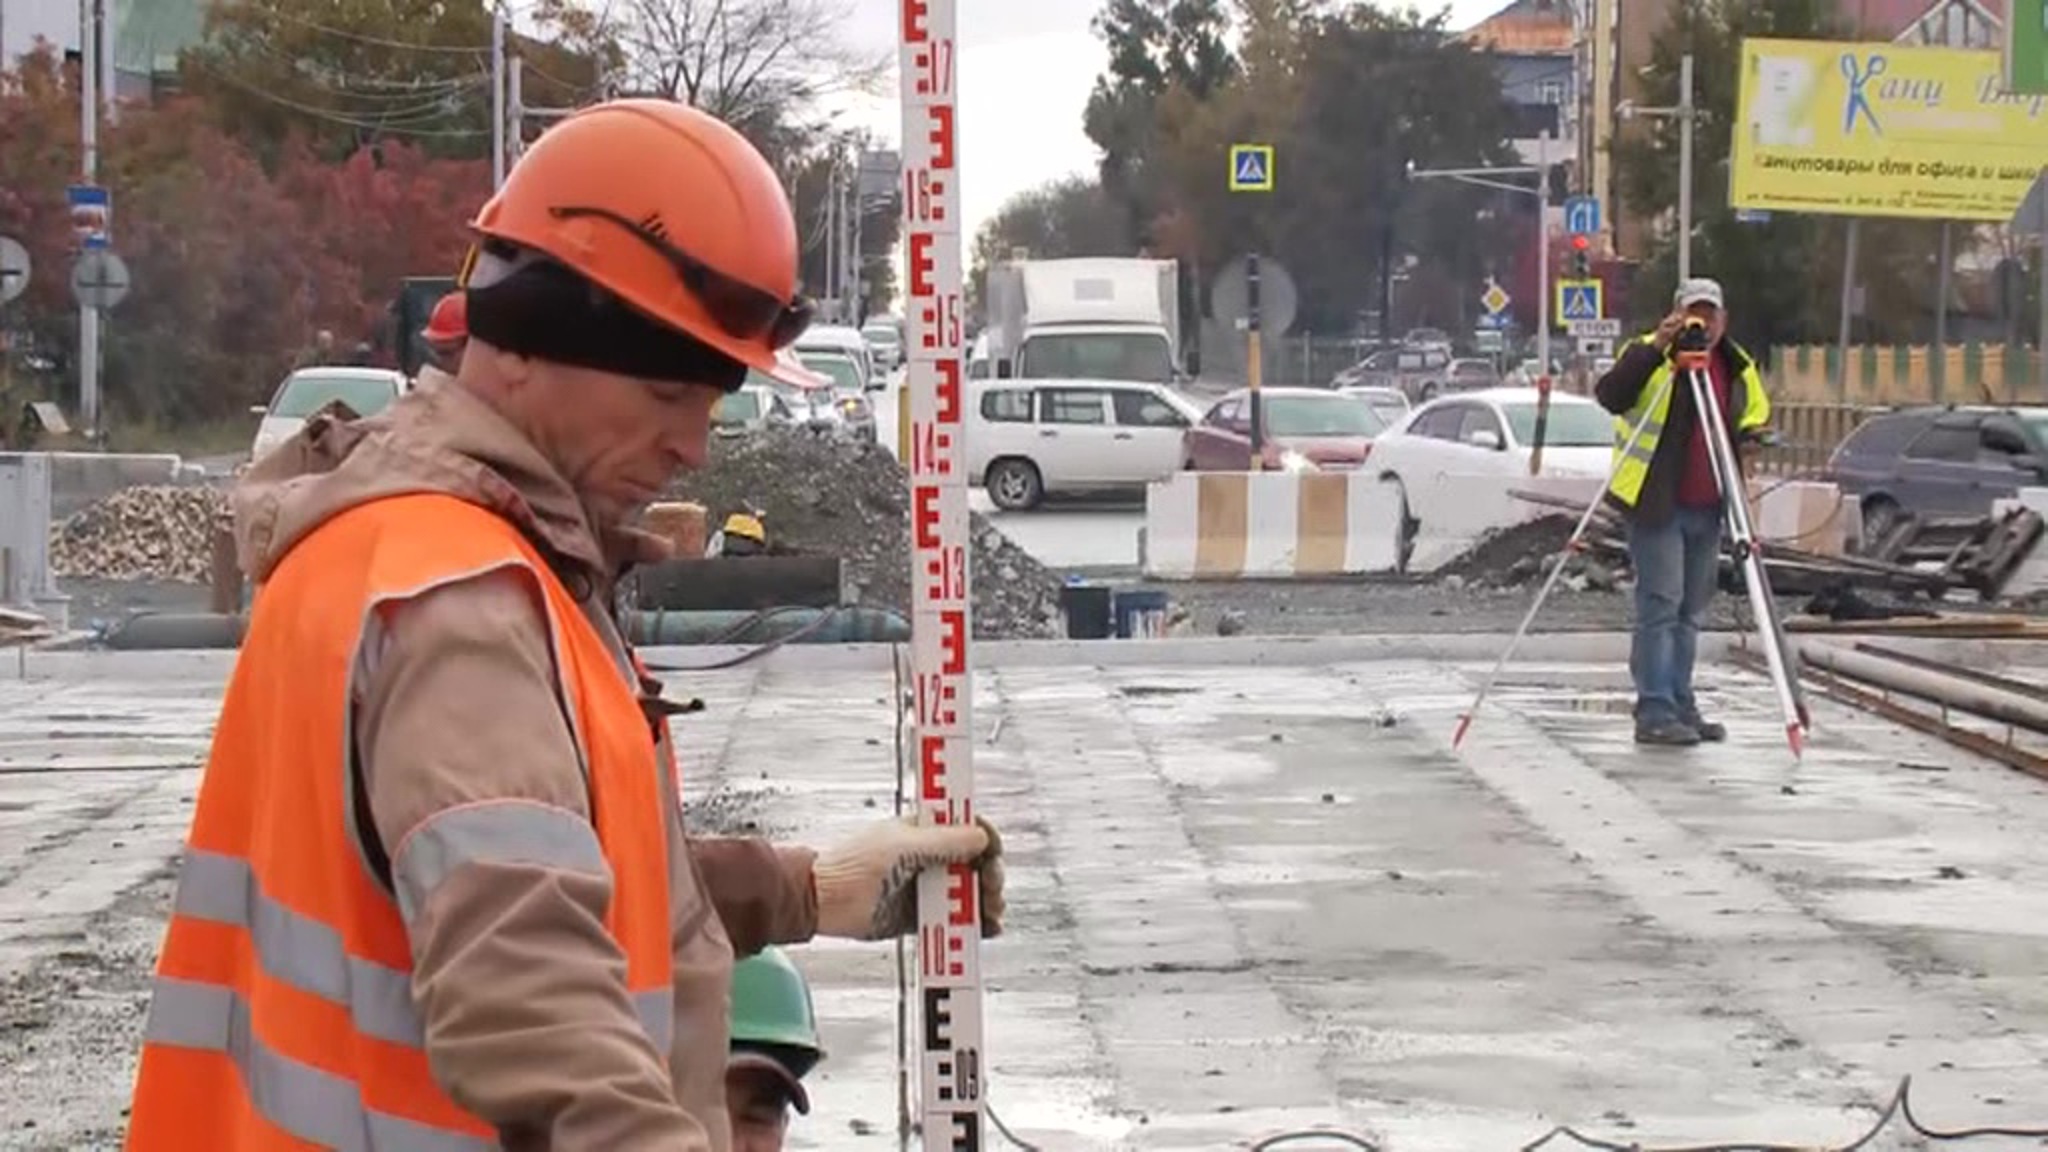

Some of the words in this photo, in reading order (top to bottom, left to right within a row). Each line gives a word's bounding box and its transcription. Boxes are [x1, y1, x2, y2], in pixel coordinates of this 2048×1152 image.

[931, 40, 952, 93] 17
[907, 169, 929, 221] 16
[938, 294, 959, 348] 15
[913, 422, 934, 475] 14
[943, 546, 965, 600] 13
[919, 673, 942, 725] 12
[923, 924, 945, 976] 10
